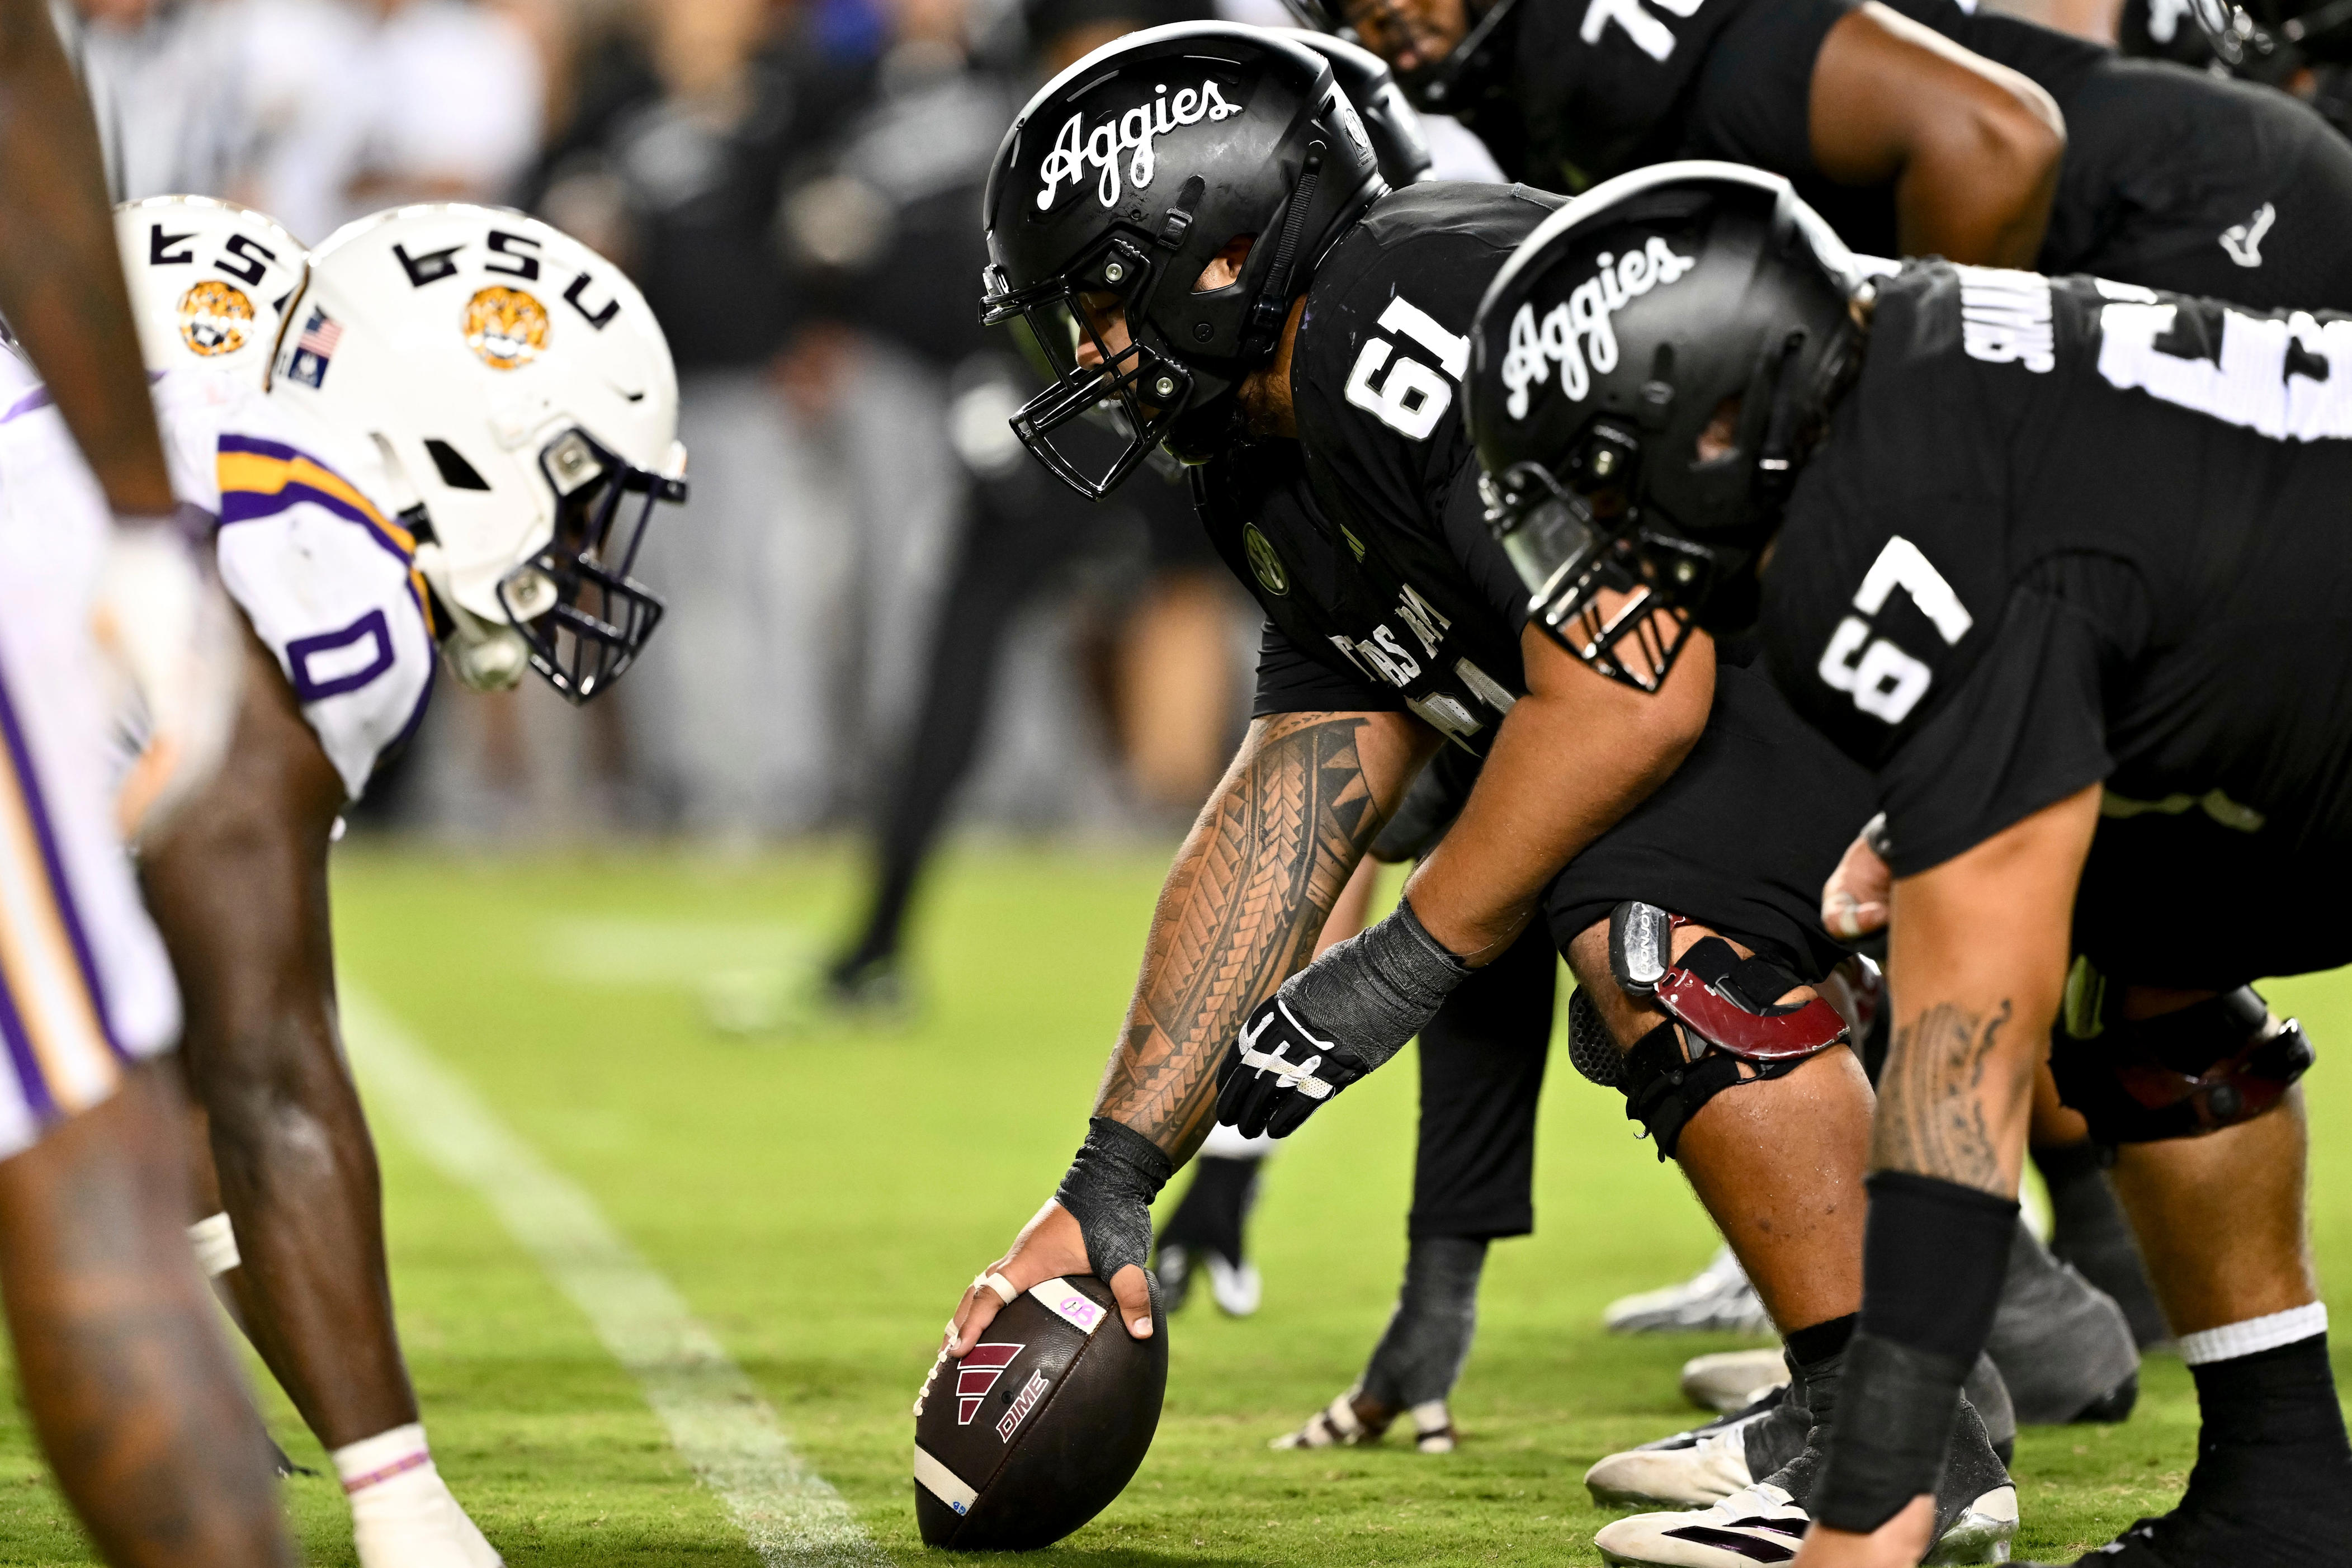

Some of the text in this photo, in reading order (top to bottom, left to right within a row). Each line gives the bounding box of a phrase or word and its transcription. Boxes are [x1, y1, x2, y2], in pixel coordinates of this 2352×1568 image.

[1037, 79, 1243, 211] Aggies
[150, 224, 294, 315] LS
[393, 230, 620, 330] LSU
[1344, 295, 1471, 441] 61
[1502, 237, 1695, 419] Aggies
[286, 609, 395, 703] 0
[1819, 535, 1973, 724] 67
[1641, 903, 1650, 974] DONJOY
[996, 1368, 1049, 1444] DIME
